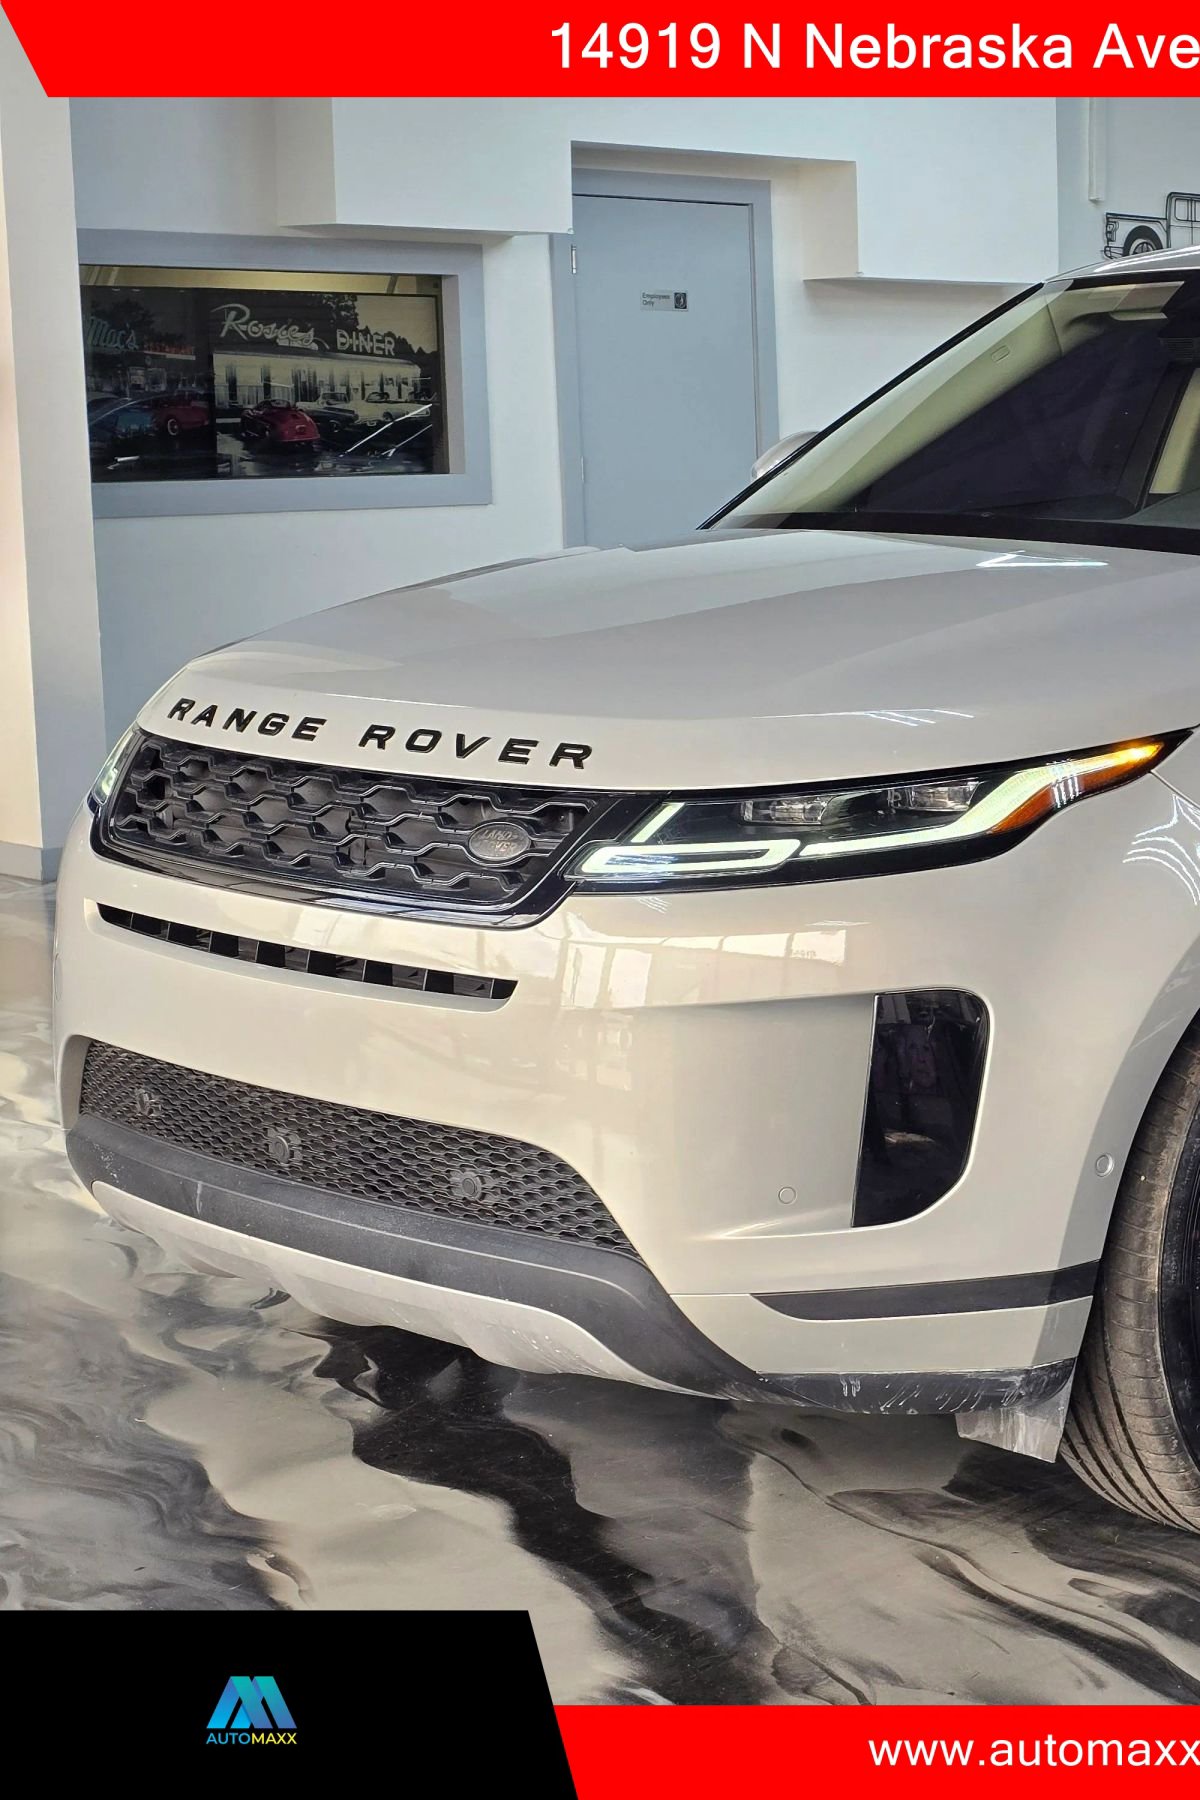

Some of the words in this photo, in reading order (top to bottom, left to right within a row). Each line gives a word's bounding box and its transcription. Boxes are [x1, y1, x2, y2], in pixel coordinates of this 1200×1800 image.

[336, 328, 396, 356] DINER
[167, 698, 327, 741] RANGE
[359, 724, 593, 770] ROVER
